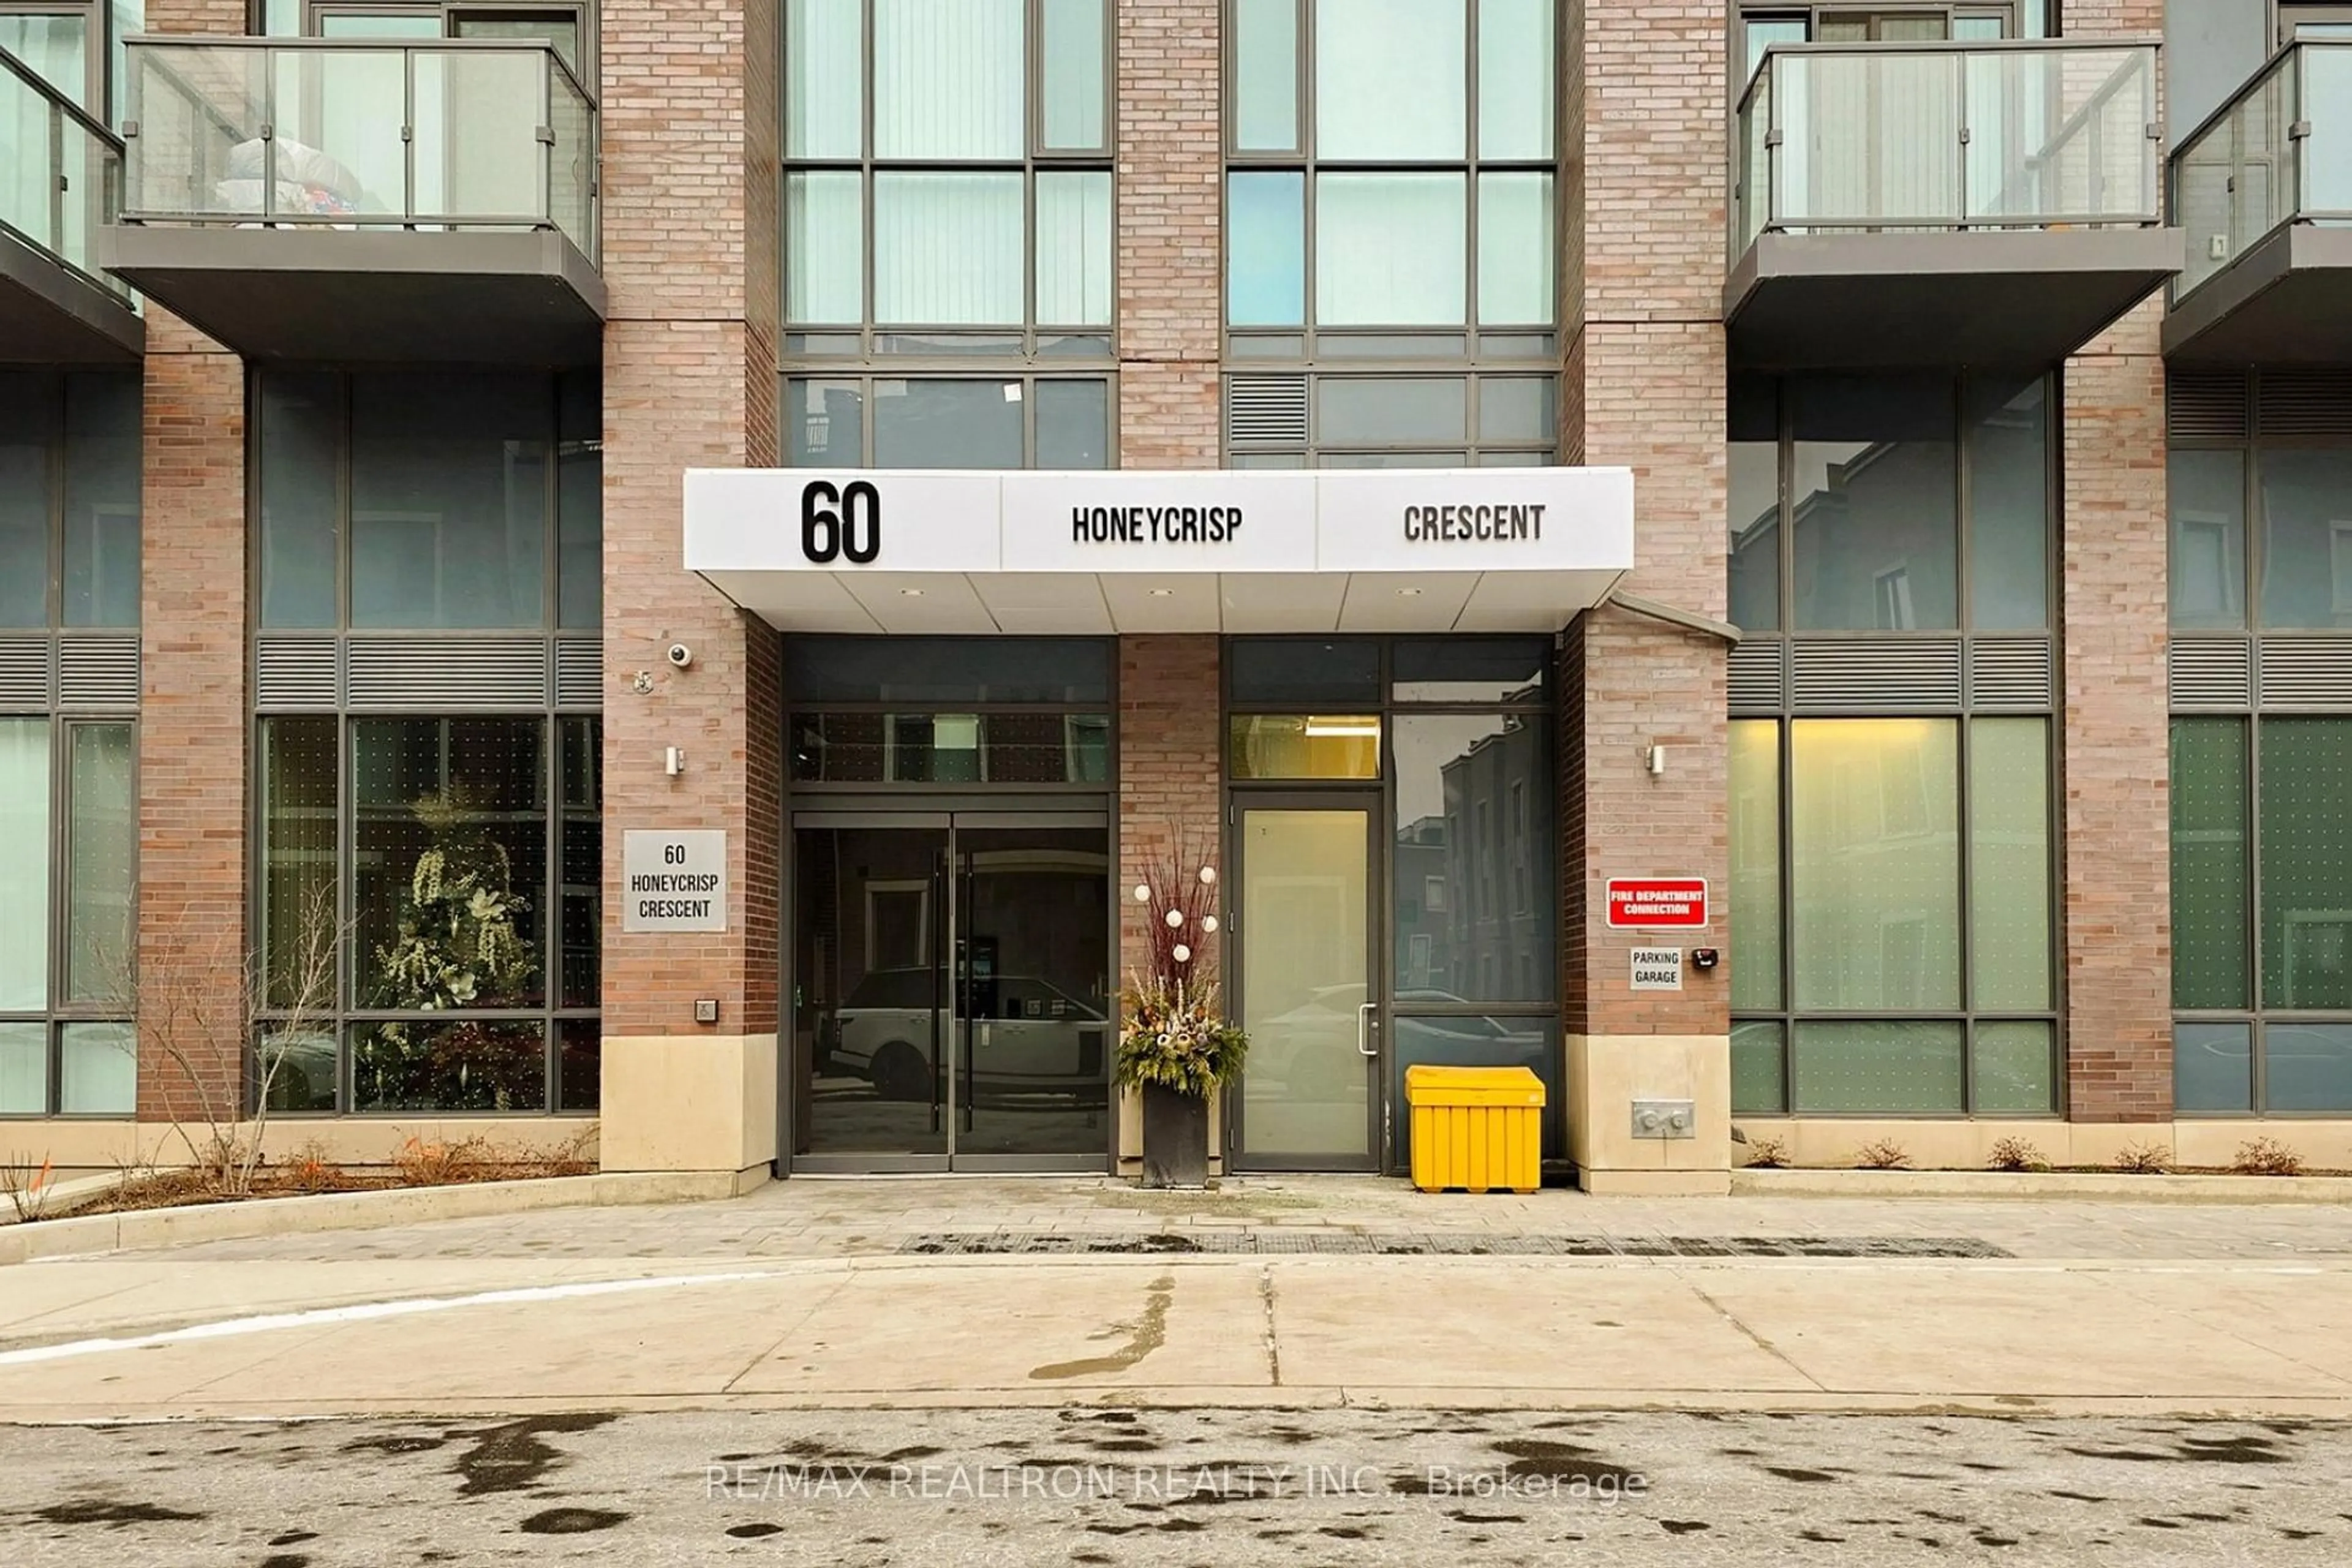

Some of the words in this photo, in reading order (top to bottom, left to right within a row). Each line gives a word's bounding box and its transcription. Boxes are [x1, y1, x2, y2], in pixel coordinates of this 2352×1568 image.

[802, 481, 880, 564] 60
[1072, 507, 1242, 543] HONEYCRISP
[1404, 505, 1546, 541] CRESCENT
[665, 845, 685, 864] 60
[631, 874, 718, 892] HONEYCRISP
[1611, 891, 1634, 902] FIRE
[1636, 891, 1703, 902] DEPARTMENT
[639, 900, 710, 918] CRESCENT
[1624, 903, 1690, 914] CONNECTION
[1634, 952, 1678, 964] PARKING
[1635, 971, 1676, 983] GARAGE
